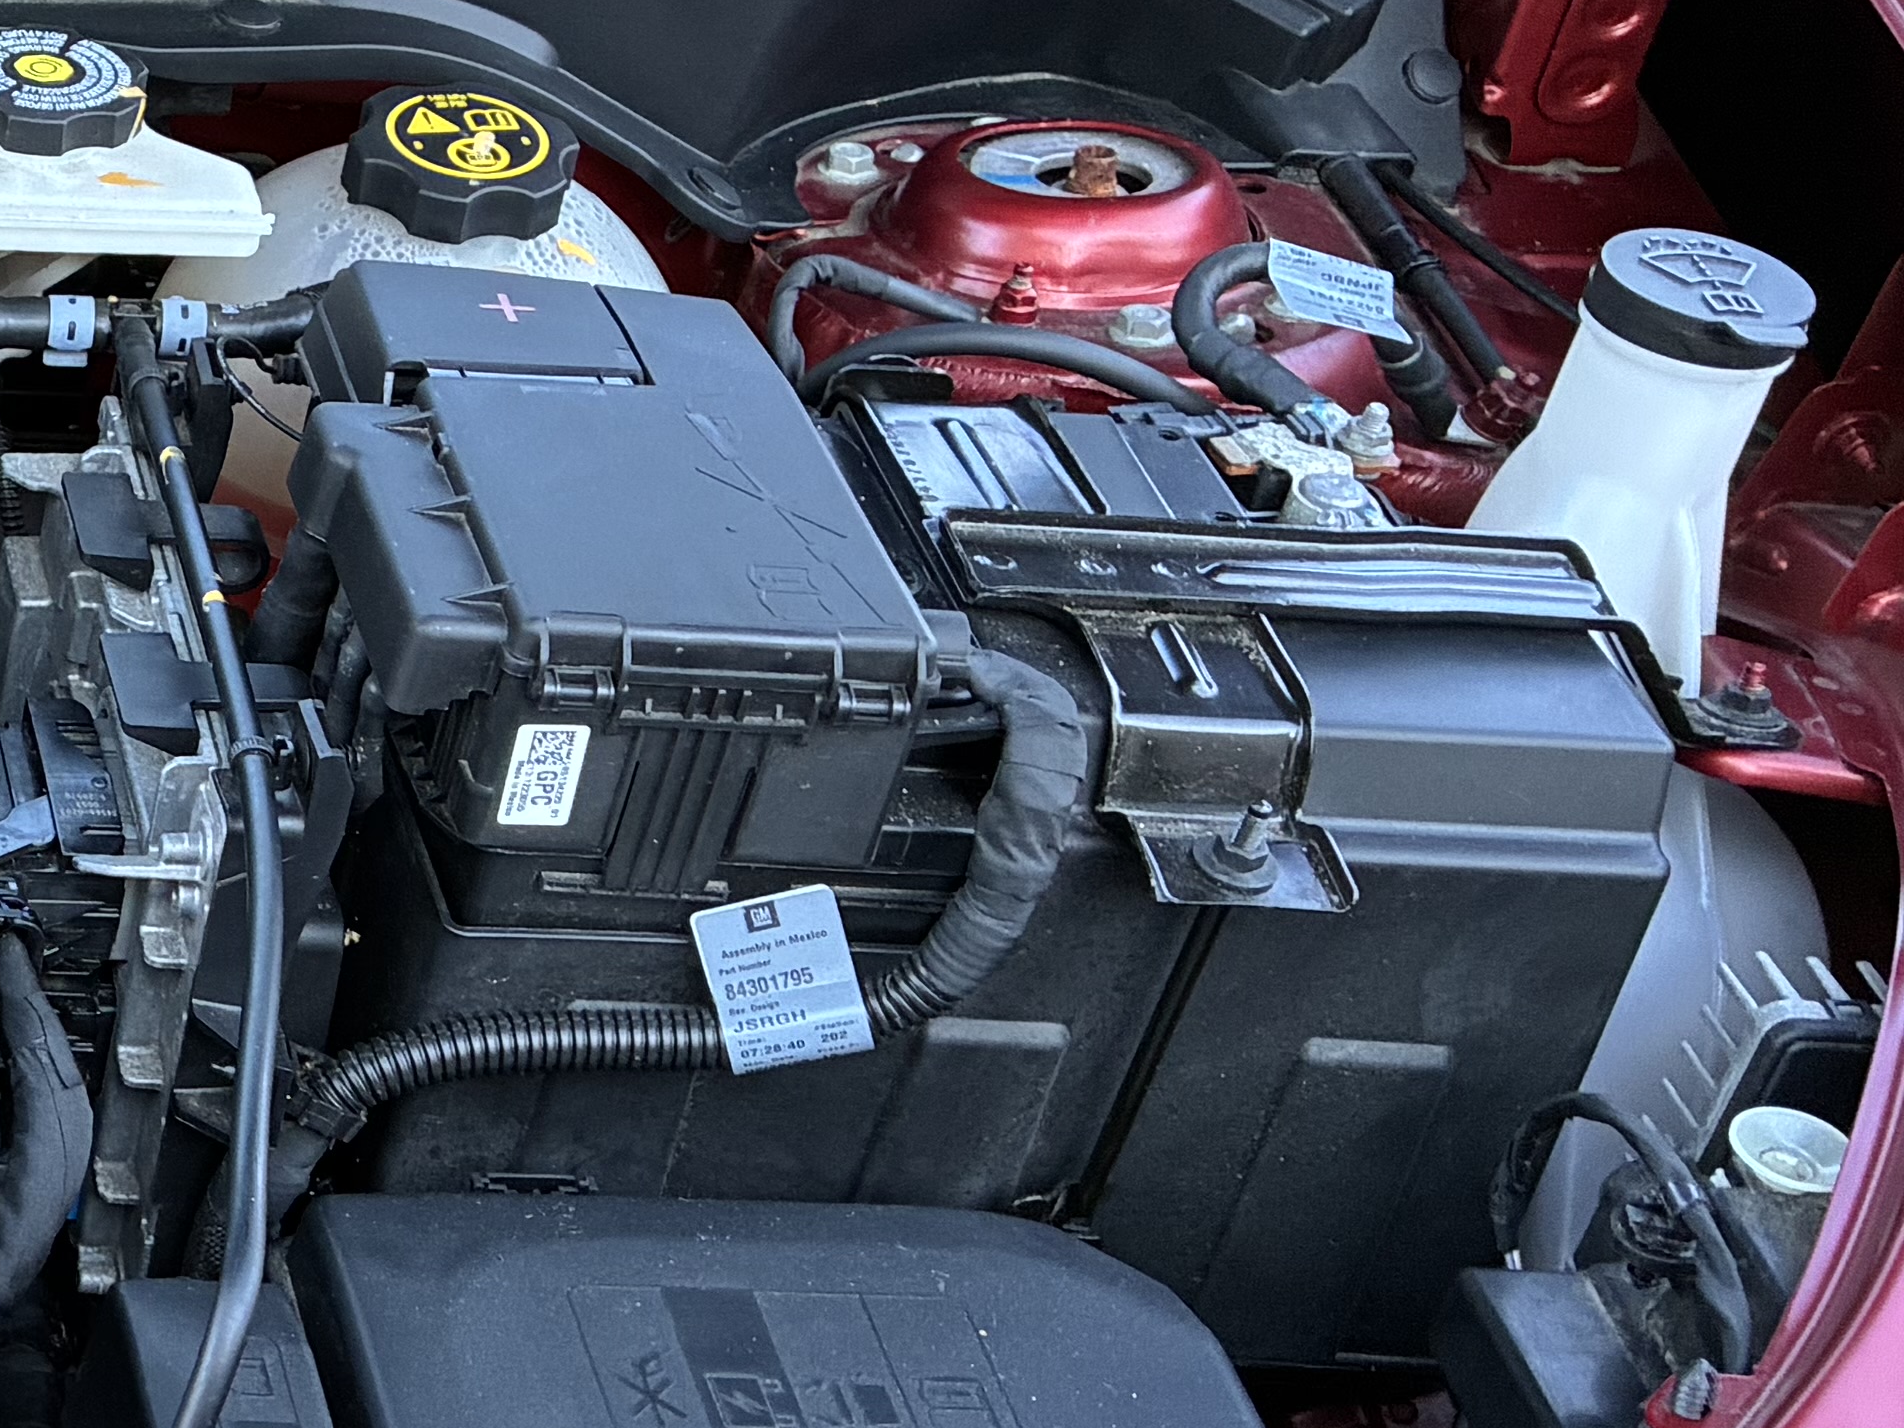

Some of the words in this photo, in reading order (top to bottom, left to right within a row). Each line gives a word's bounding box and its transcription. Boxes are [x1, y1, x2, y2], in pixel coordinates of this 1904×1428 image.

[530, 770, 559, 806] GPC
[721, 942, 772, 960] Assembly
[774, 938, 787, 949] in
[789, 928, 829, 945] Mexico
[724, 966, 815, 1001] 84301795
